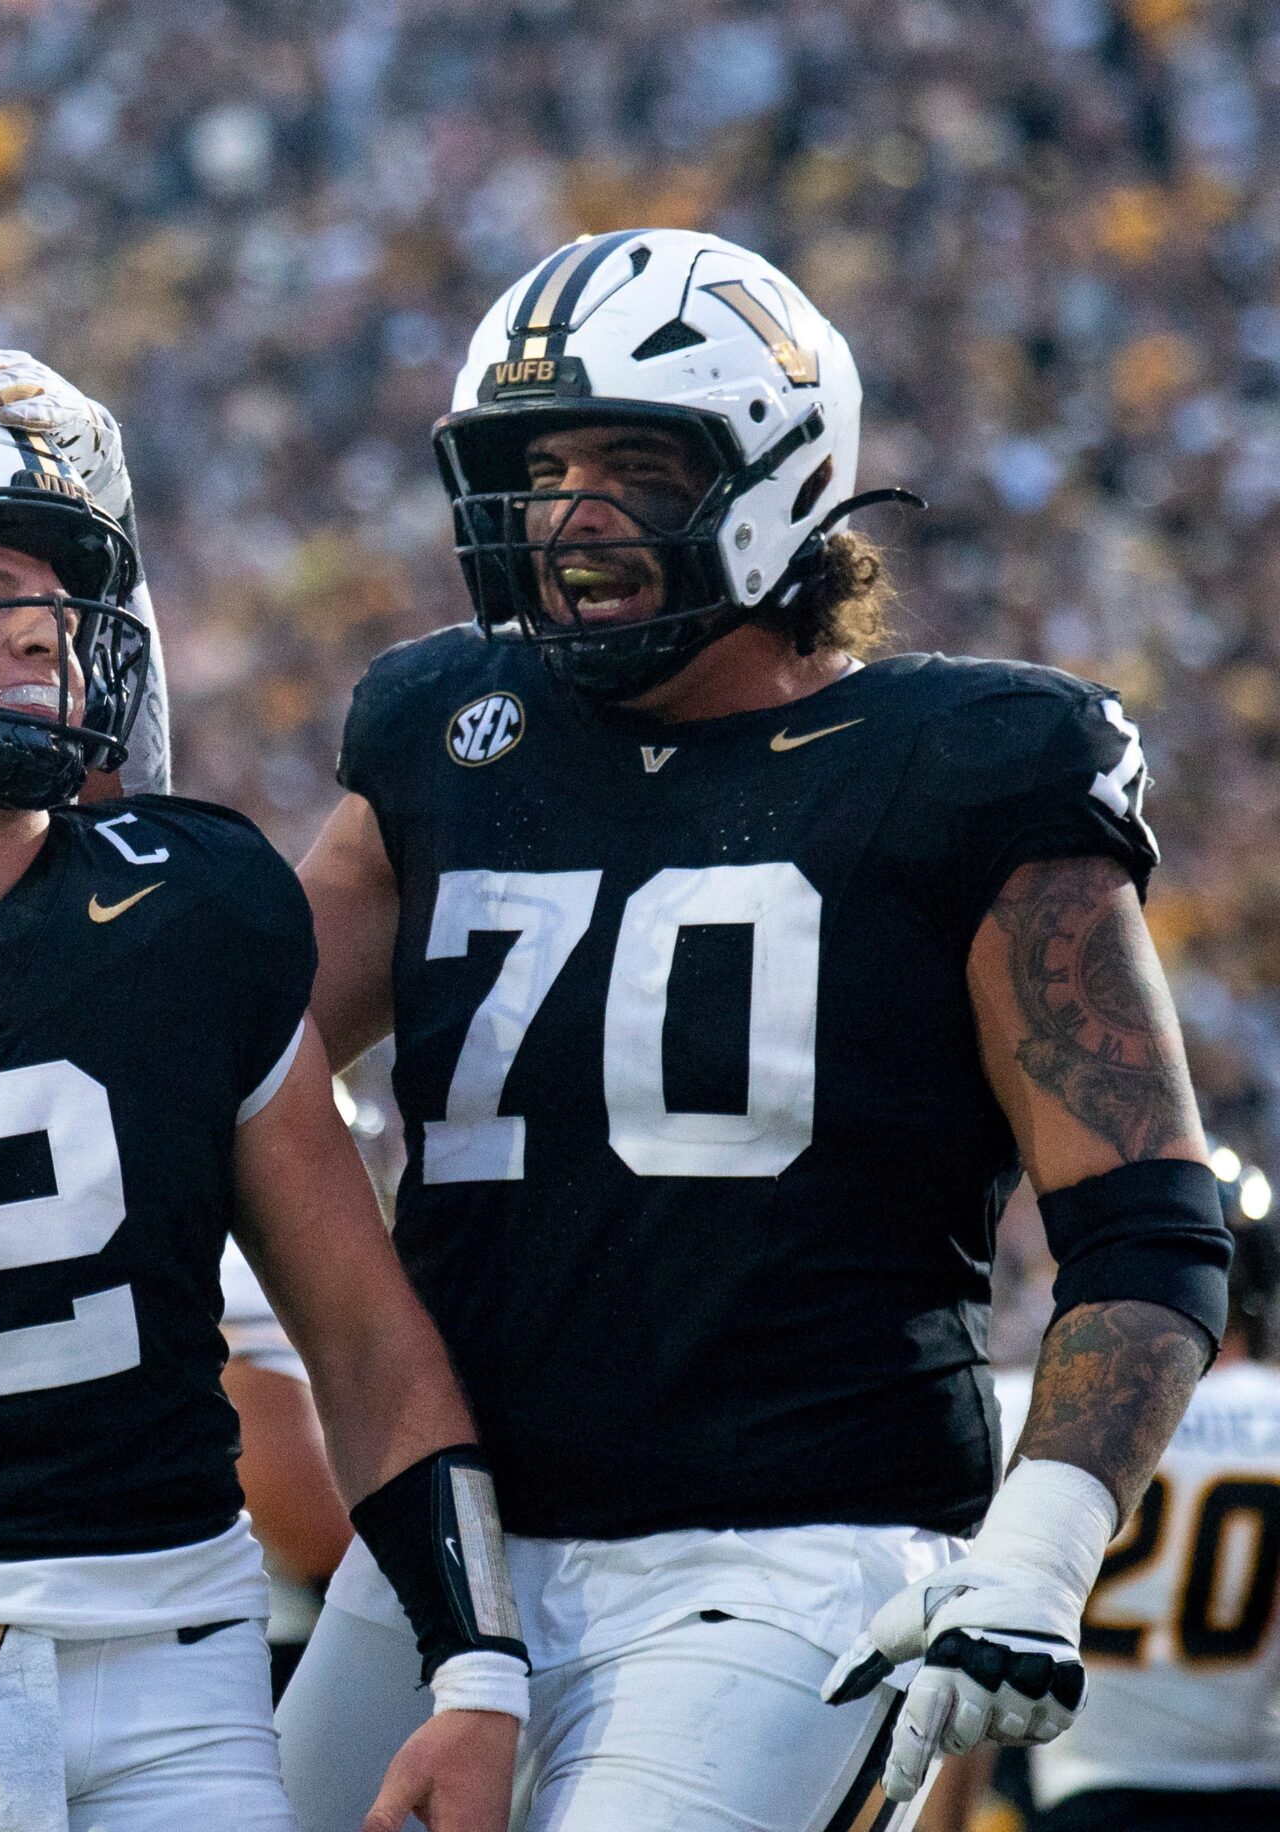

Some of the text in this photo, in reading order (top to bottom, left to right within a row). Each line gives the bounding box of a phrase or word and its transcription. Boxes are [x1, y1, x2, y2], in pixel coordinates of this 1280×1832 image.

[495, 361, 556, 386] VUFB
[452, 697, 520, 760] SEC
[640, 746, 678, 774] V
[94, 812, 170, 865] C
[423, 862, 822, 1185] 70
[1080, 1472, 1280, 1664] 20
